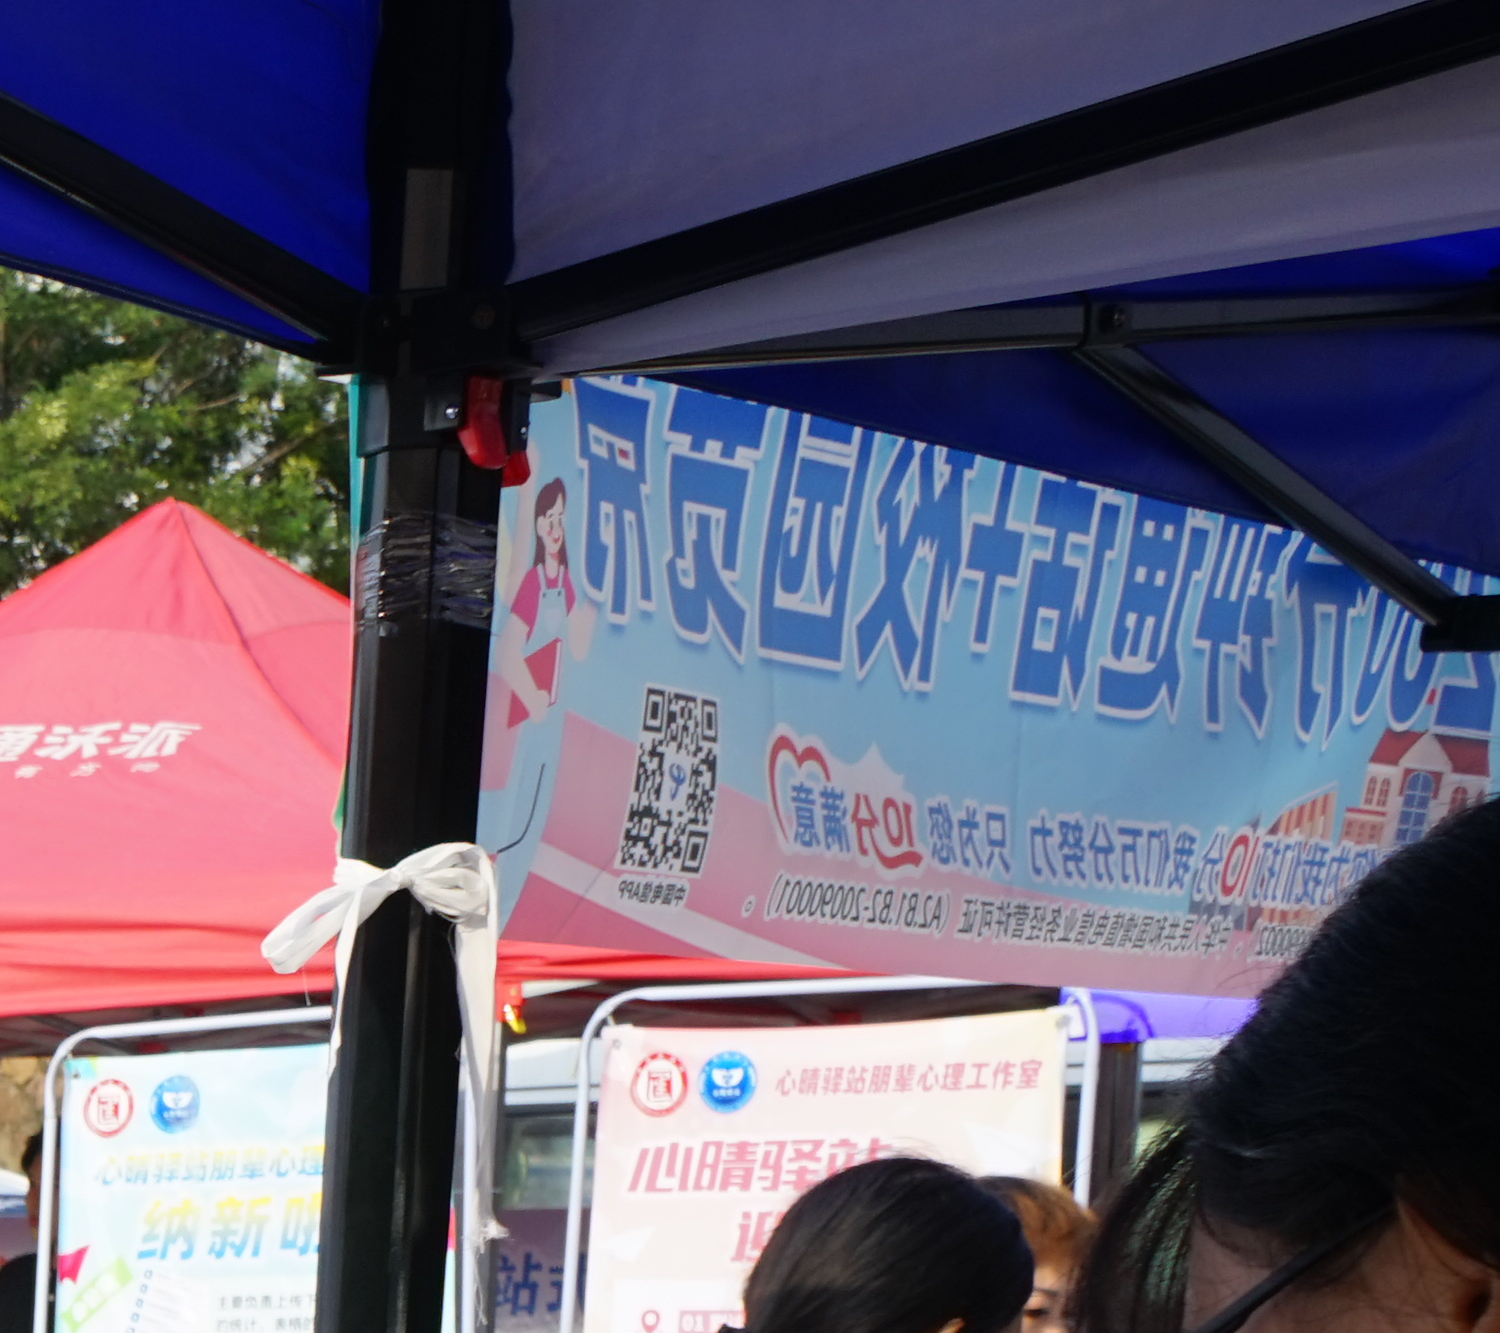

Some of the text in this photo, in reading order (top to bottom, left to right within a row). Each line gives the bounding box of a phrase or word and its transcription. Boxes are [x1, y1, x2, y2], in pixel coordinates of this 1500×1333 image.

[775, 1058, 1043, 1098] 心晴驿站朋辈心理工作室
